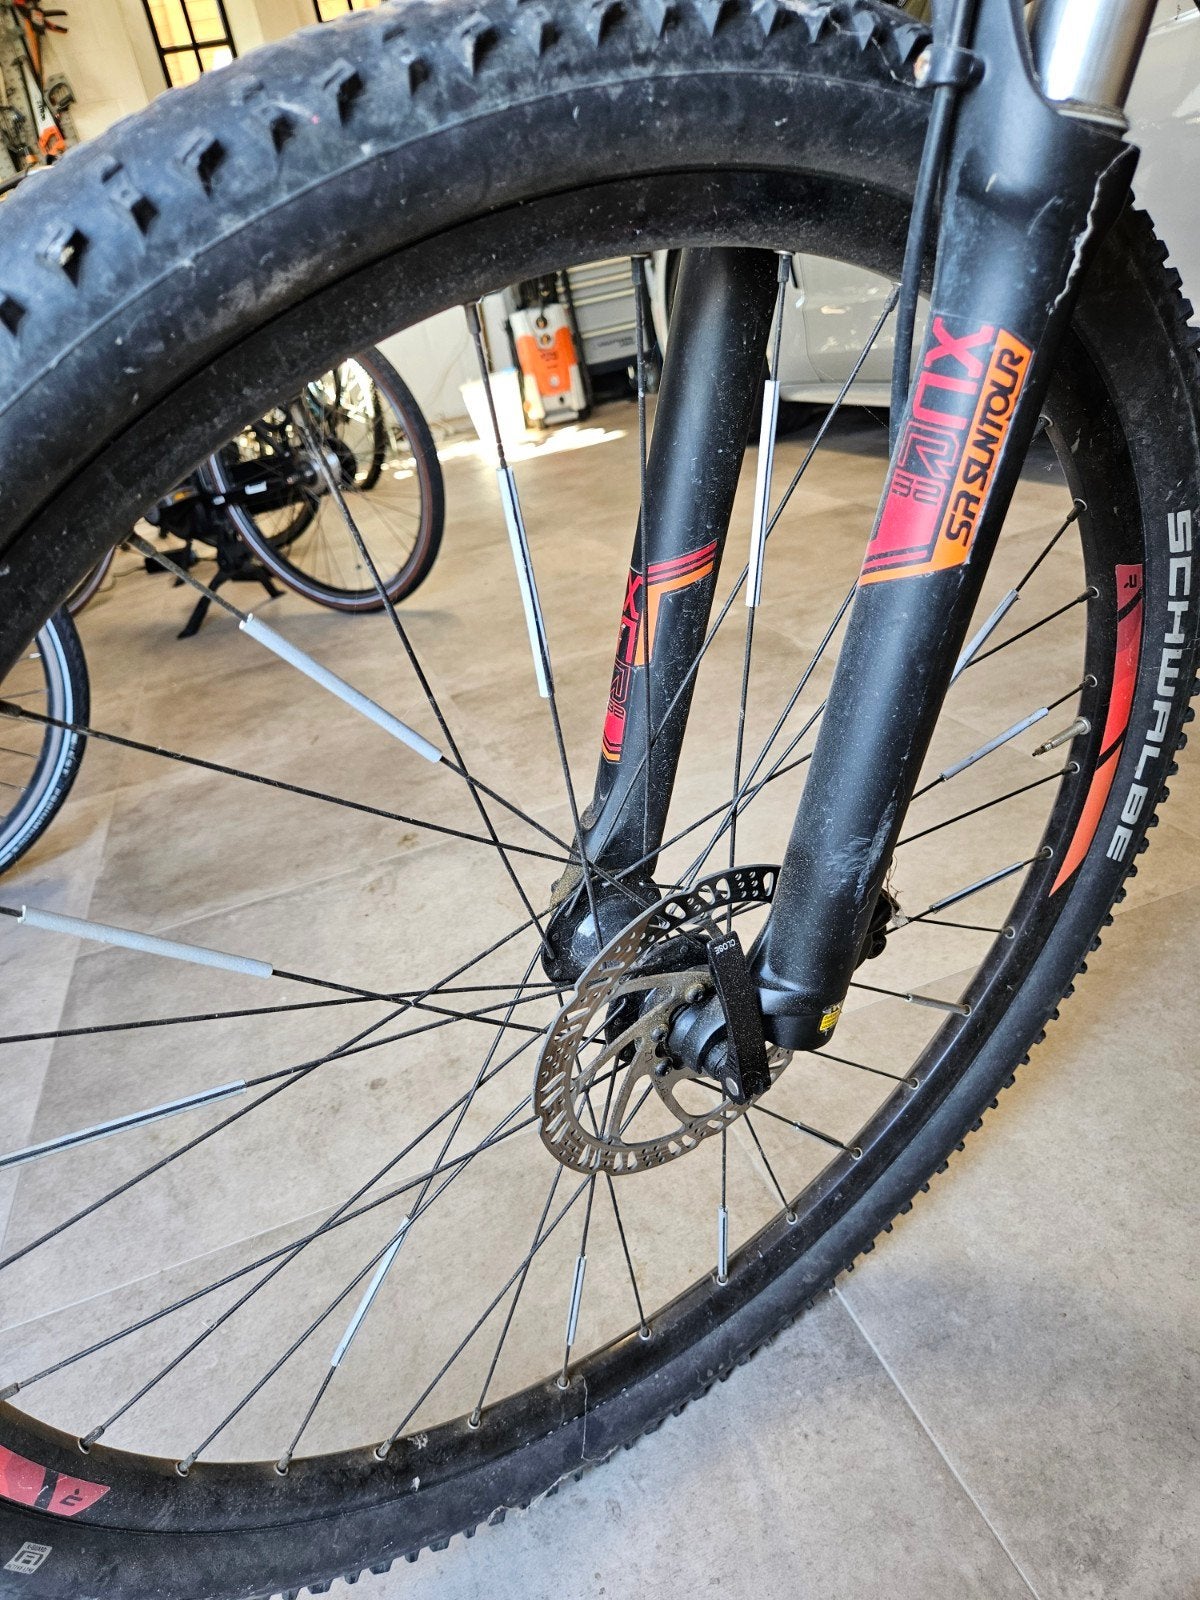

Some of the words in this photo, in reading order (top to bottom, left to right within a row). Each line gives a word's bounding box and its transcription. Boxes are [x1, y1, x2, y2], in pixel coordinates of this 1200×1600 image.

[962, 348, 1024, 491] SUNTOUR
[946, 490, 981, 546] SR
[1106, 510, 1193, 862] SCHWALBE
[714, 939, 736, 955] CLOSE
